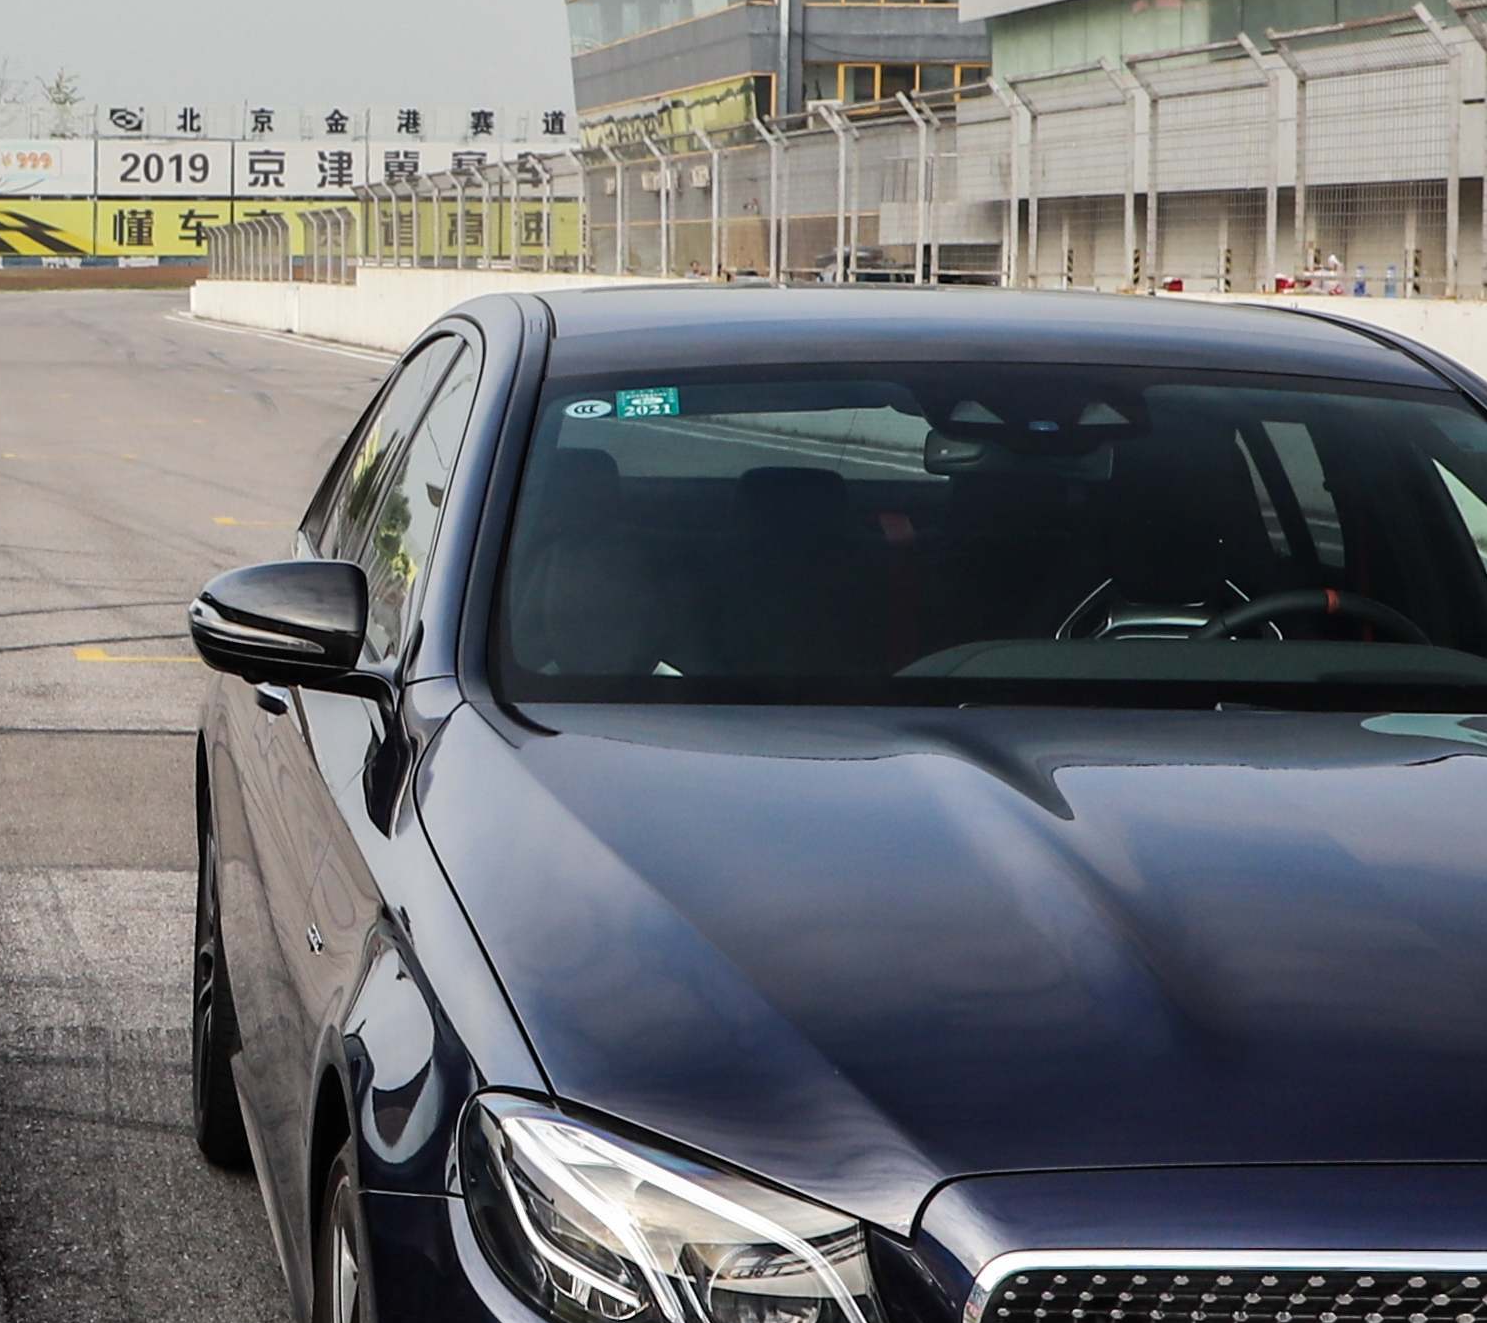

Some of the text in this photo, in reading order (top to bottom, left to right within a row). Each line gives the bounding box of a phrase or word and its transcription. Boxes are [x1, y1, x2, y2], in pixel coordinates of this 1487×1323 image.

[177, 107, 567, 136] 北京金港赛道
[624, 404, 672, 417] 2021
